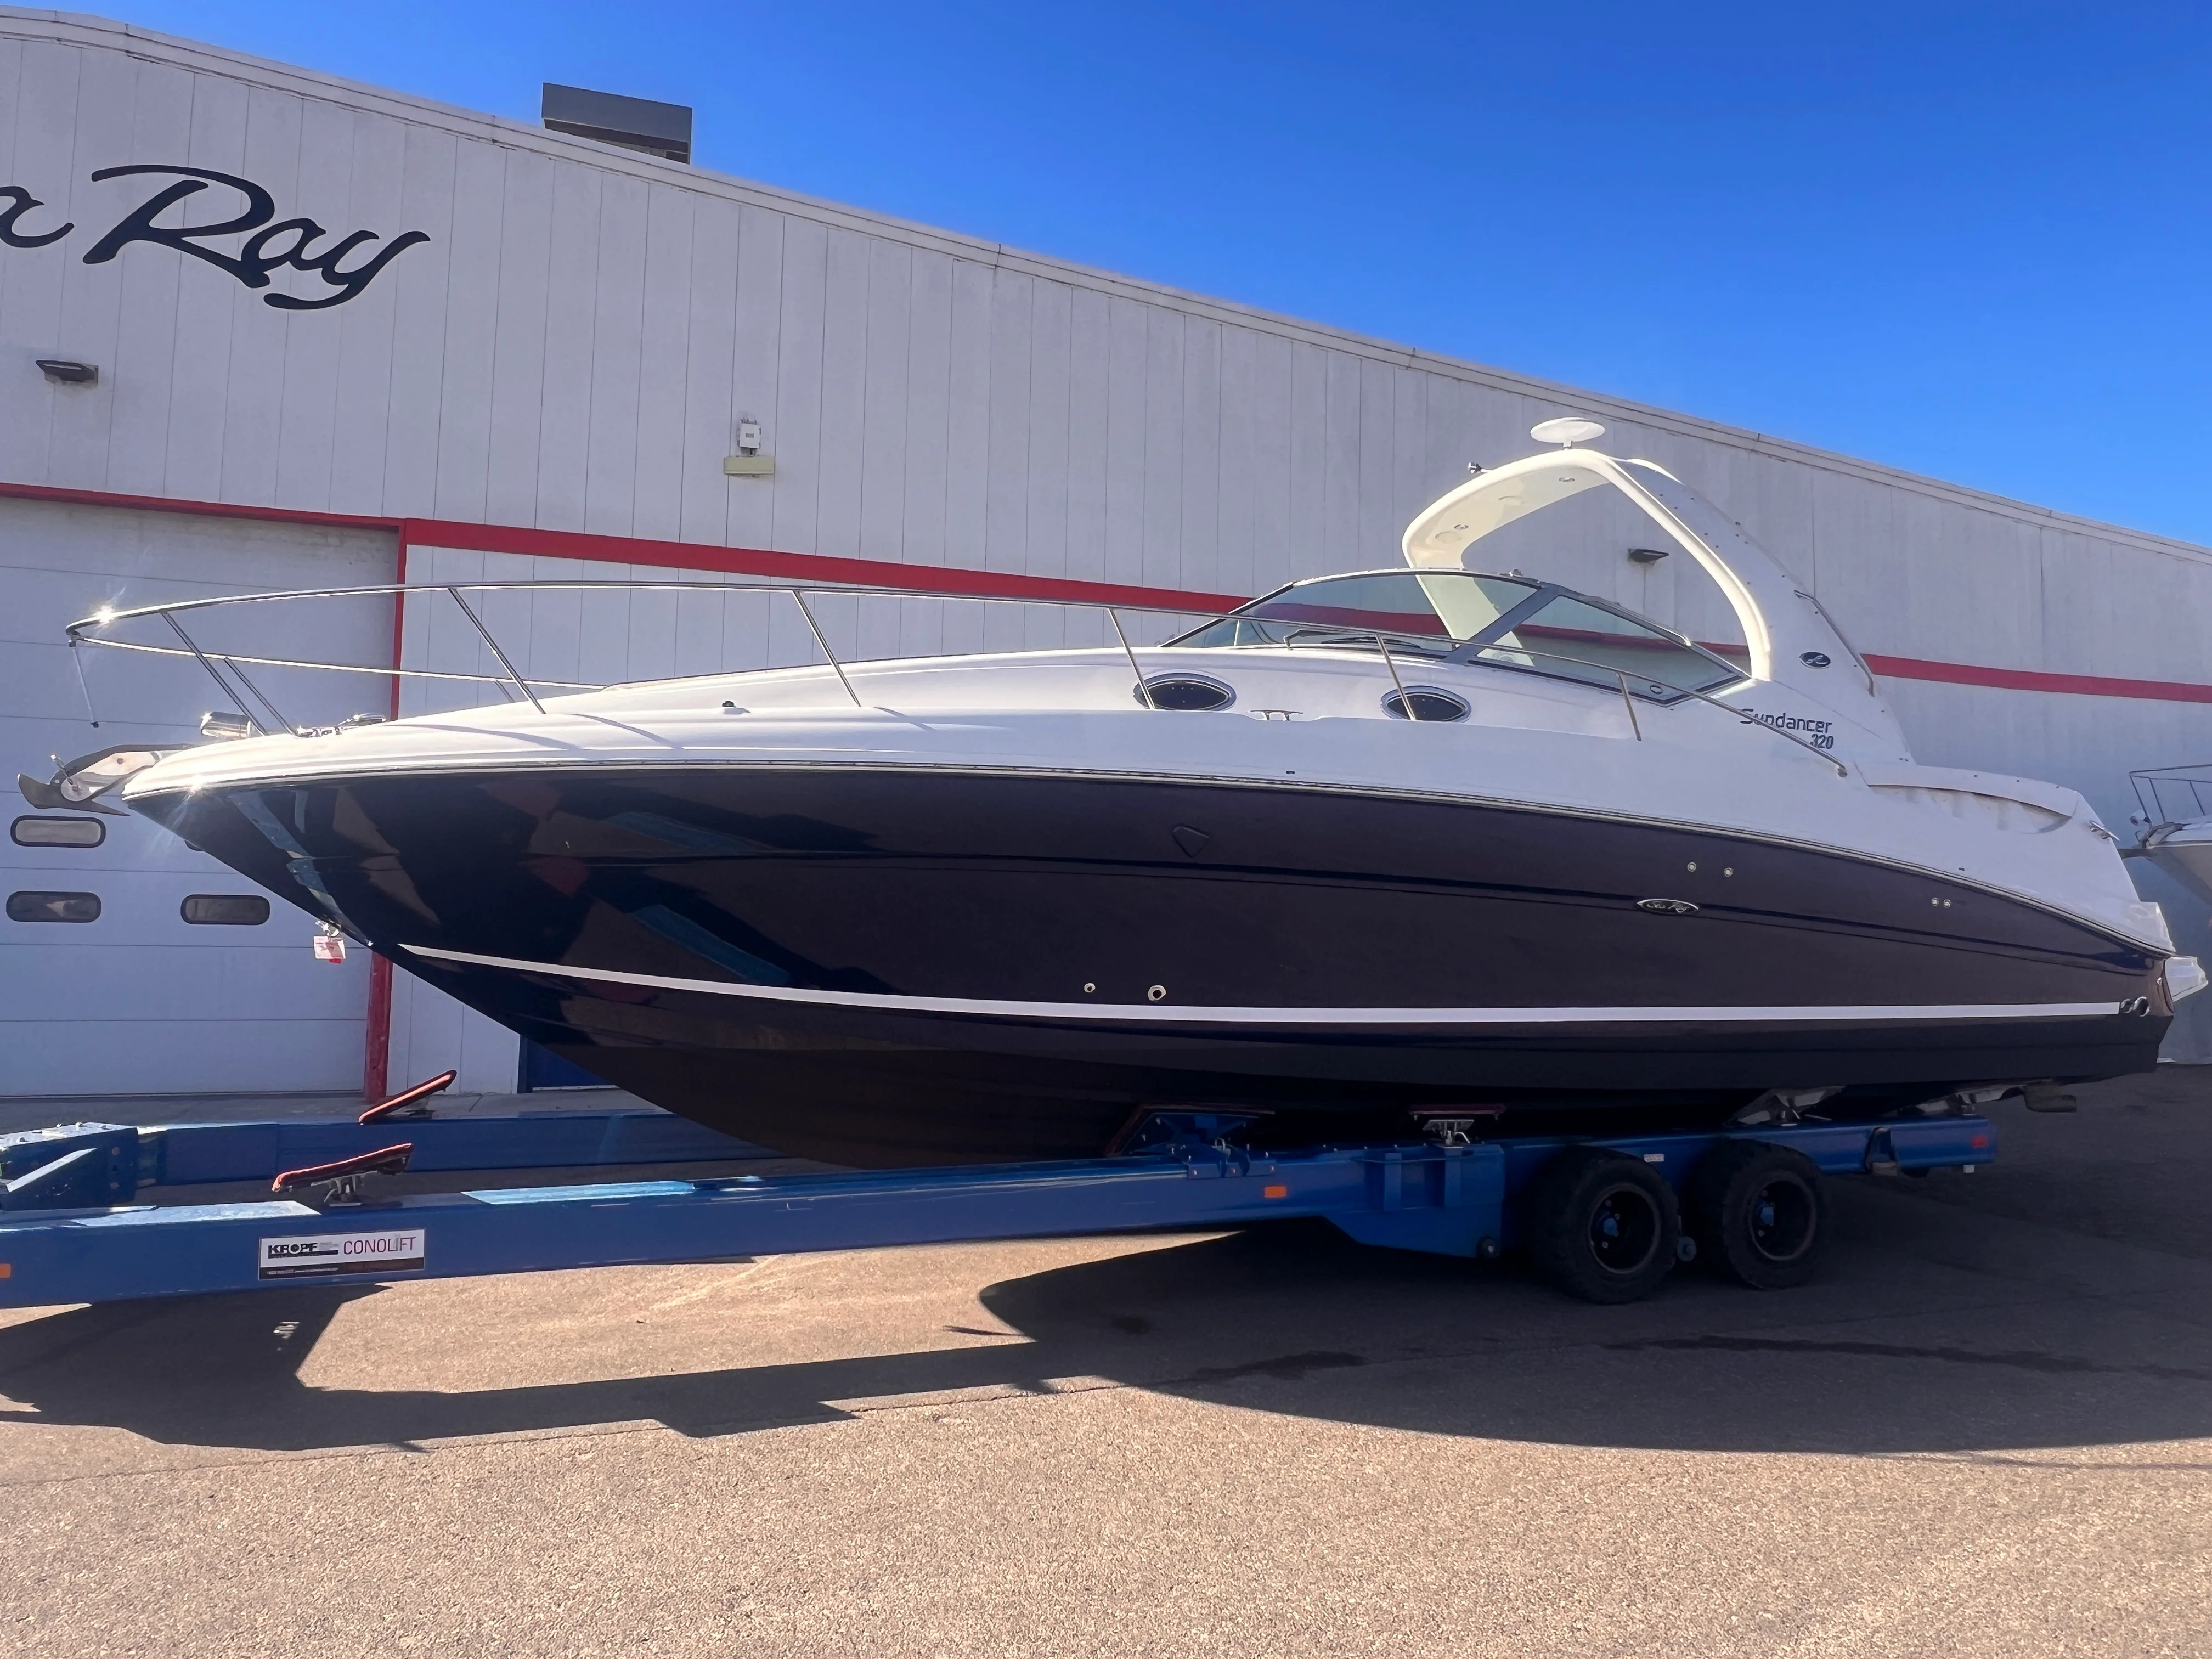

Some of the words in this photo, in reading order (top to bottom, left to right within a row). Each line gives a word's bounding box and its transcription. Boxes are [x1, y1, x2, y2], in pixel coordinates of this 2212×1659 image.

[83, 165, 430, 309] Ray
[1810, 733, 1834, 749] 320
[343, 1236, 416, 1255] CONOLIFT
